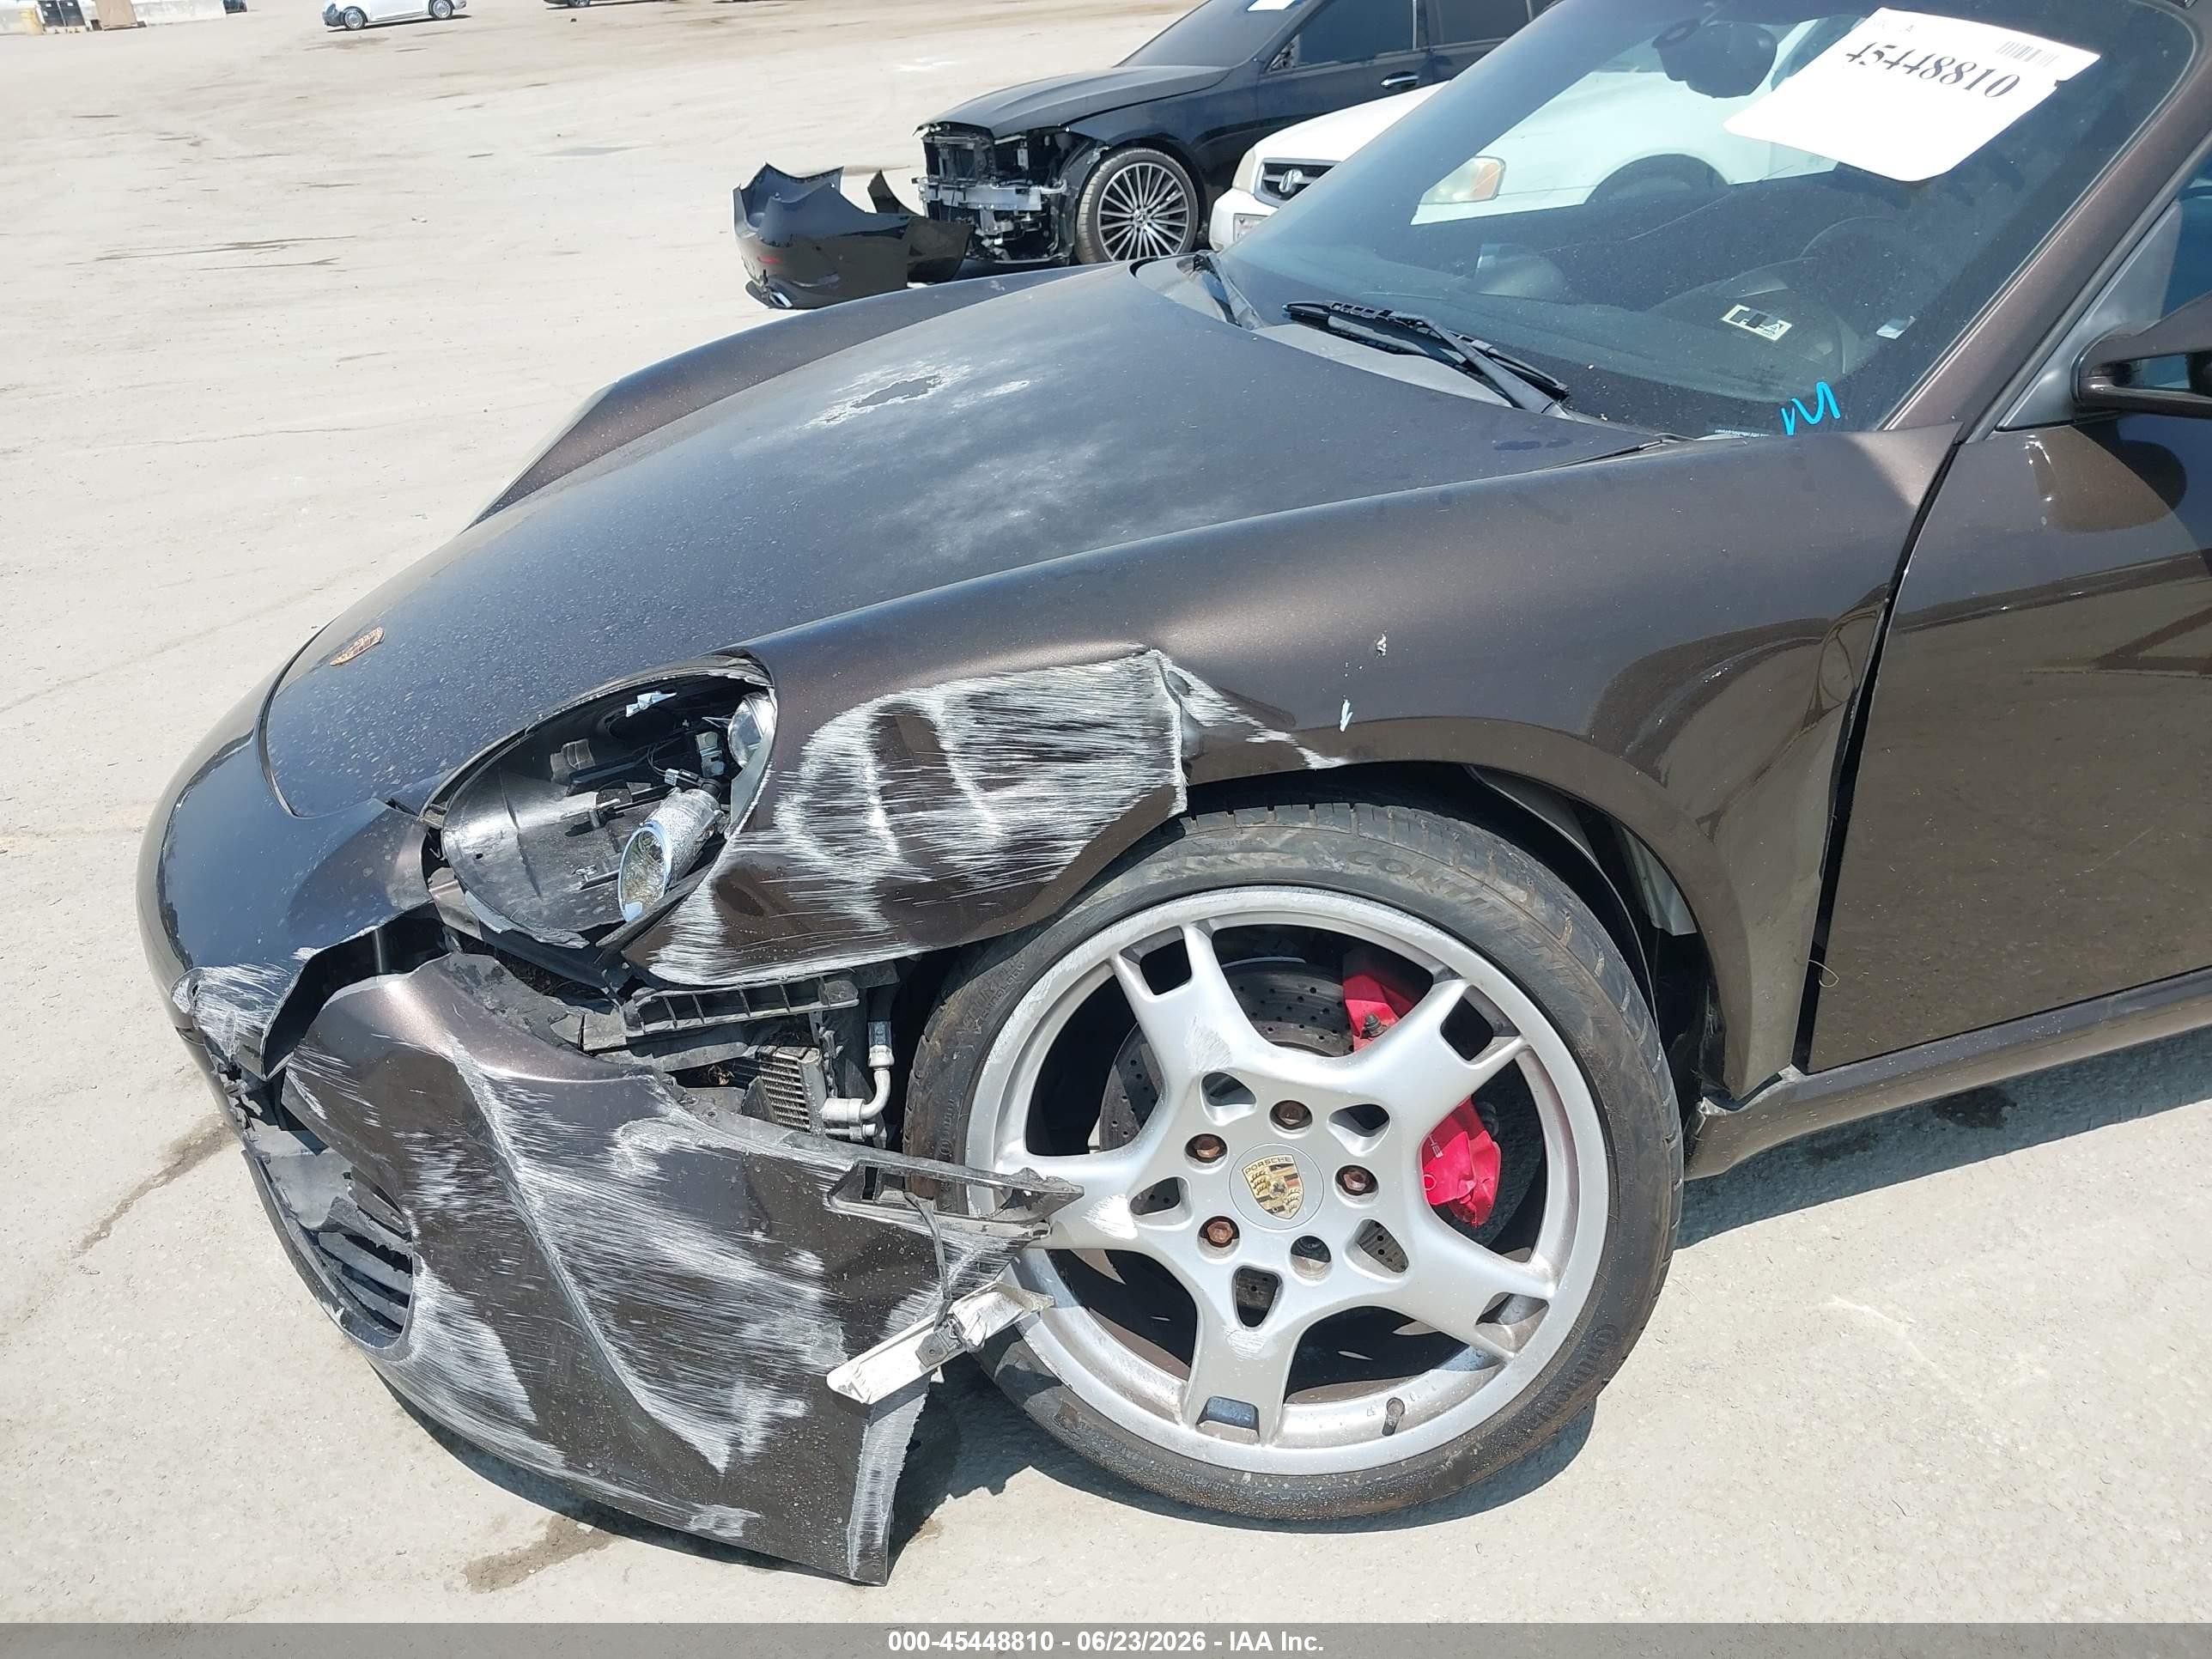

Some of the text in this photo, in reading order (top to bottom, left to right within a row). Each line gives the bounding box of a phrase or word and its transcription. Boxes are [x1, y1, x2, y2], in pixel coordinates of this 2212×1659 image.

[1845, 42, 2021, 98] 45448810
[974, 963, 1025, 1034] ECHNOLOGY
[1245, 1156, 1293, 1175] PORSCHE
